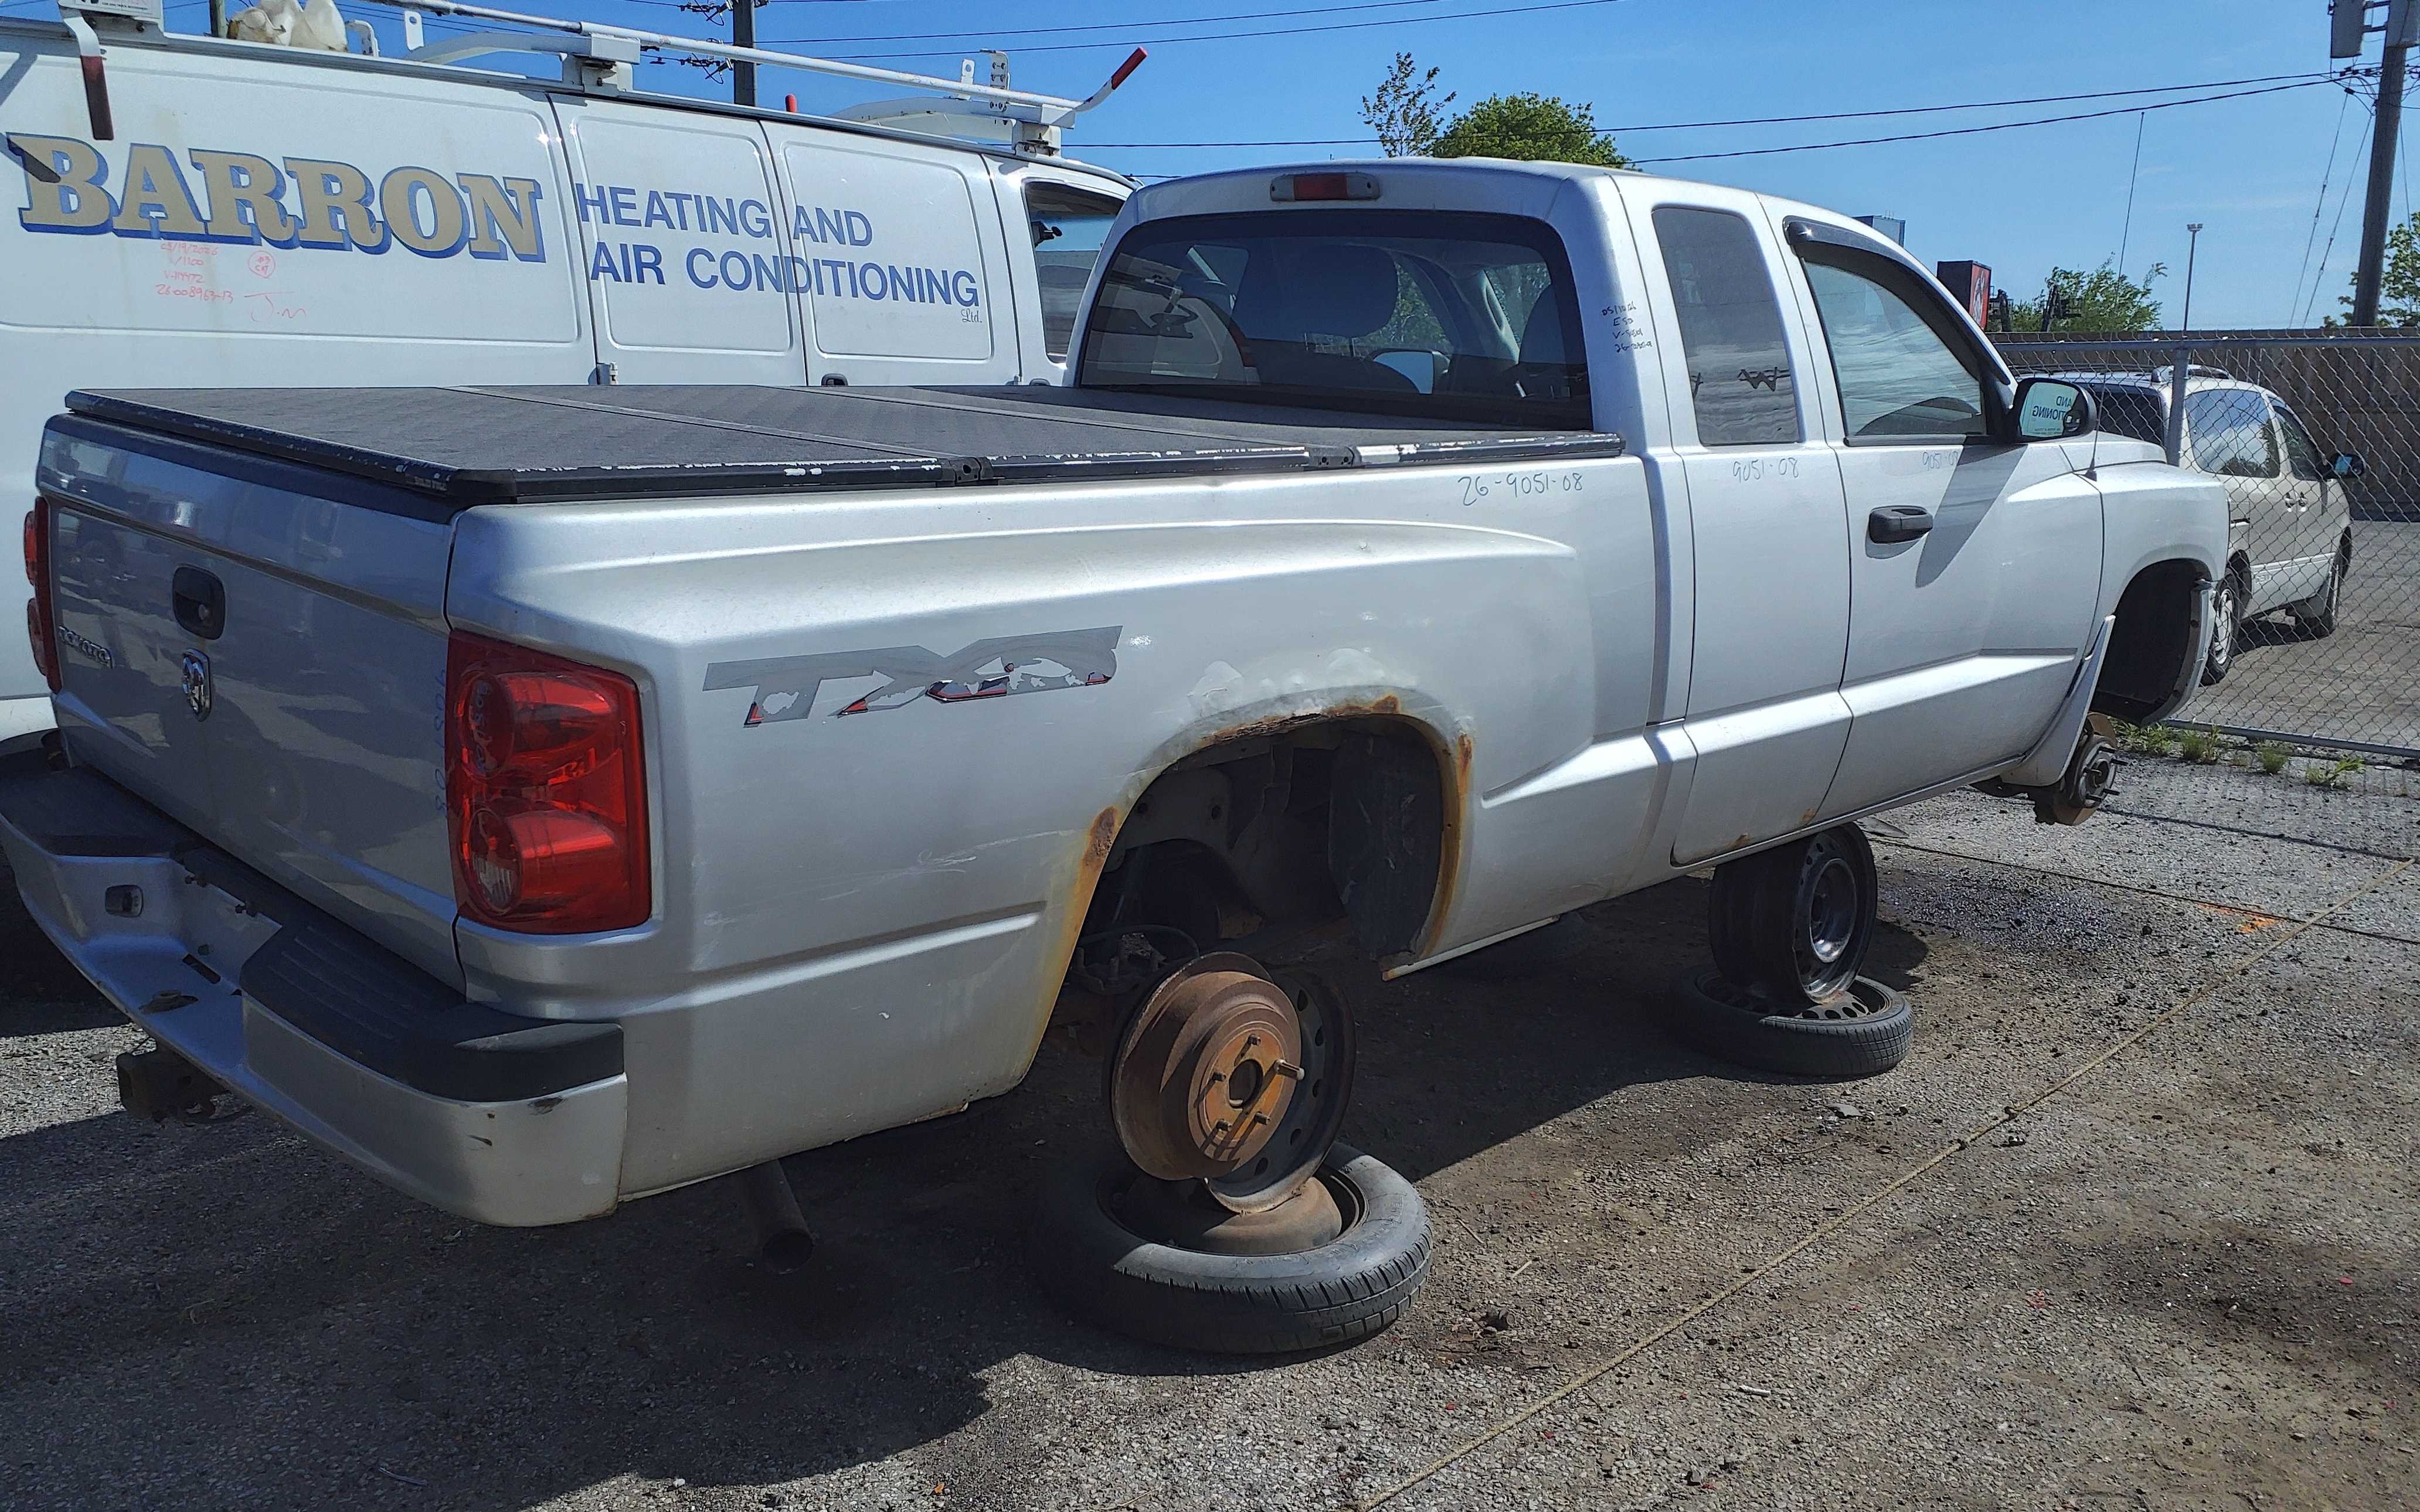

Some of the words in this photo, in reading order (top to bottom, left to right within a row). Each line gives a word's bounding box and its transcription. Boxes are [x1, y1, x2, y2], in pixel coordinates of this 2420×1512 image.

[5, 131, 546, 263] BARRON
[575, 182, 772, 239] HEATING
[793, 205, 872, 247] AND
[590, 241, 666, 285] AIR
[686, 248, 980, 307] CONDITIONING
[1457, 472, 1583, 506] 26-9051-08
